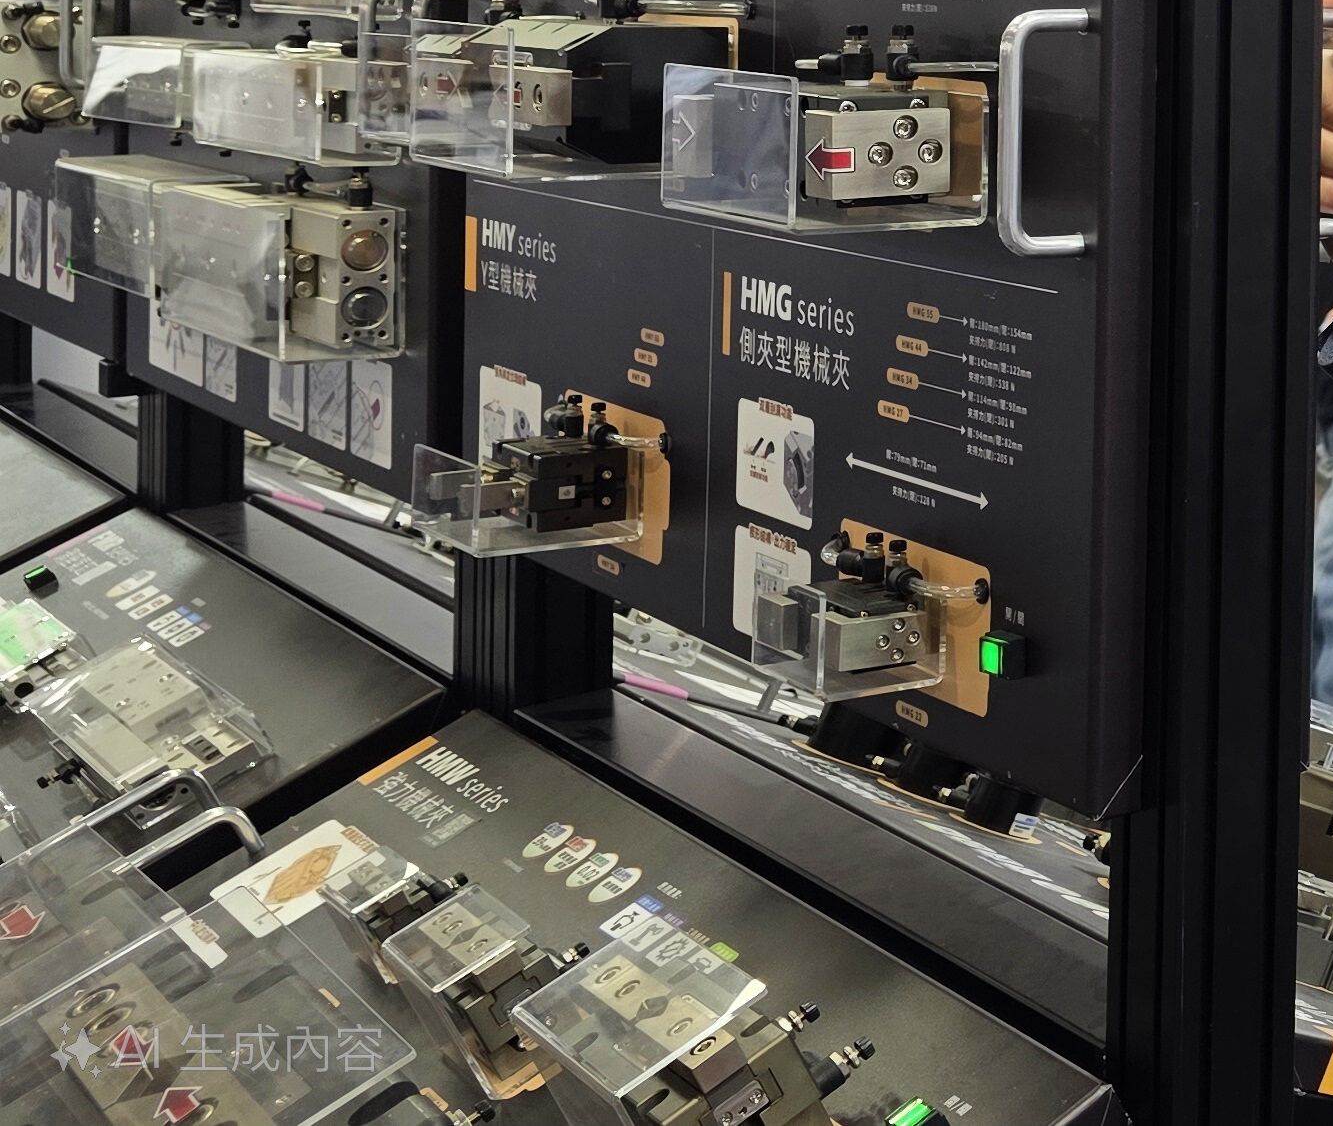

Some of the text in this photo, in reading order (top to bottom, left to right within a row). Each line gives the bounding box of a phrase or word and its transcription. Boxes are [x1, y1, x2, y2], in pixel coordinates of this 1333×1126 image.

[481, 217, 557, 264] HMY series
[480, 259, 538, 302] Y型機械夾
[740, 275, 856, 337] HMG series
[739, 324, 851, 392] 側夾型機械夾
[414, 745, 510, 814] HMW series
